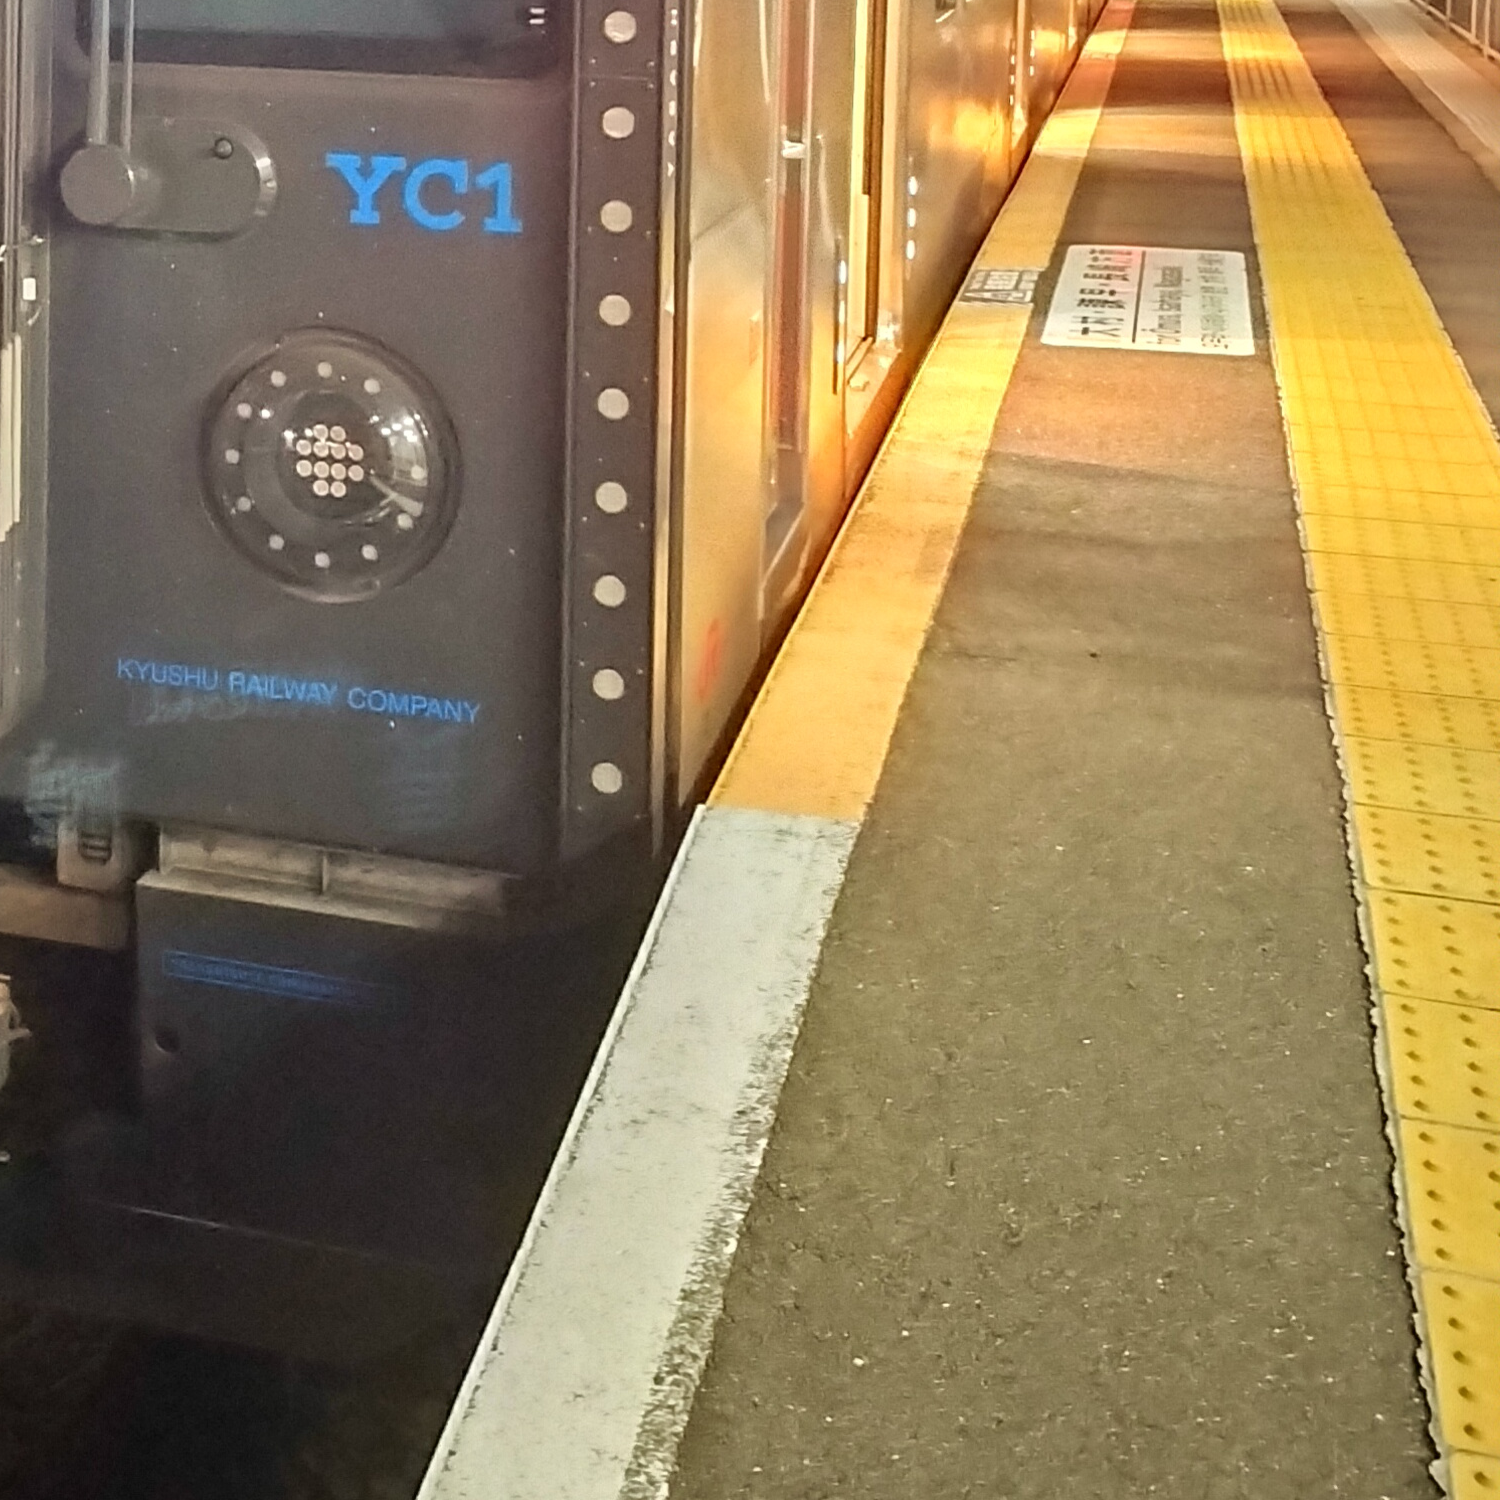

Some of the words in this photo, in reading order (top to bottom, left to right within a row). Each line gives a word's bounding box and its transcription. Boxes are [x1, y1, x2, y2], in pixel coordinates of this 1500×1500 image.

[325, 152, 523, 233] YC1
[116, 658, 219, 692] KYUSHU
[229, 671, 338, 706] RAILWAY
[347, 687, 481, 725] COMPANY
